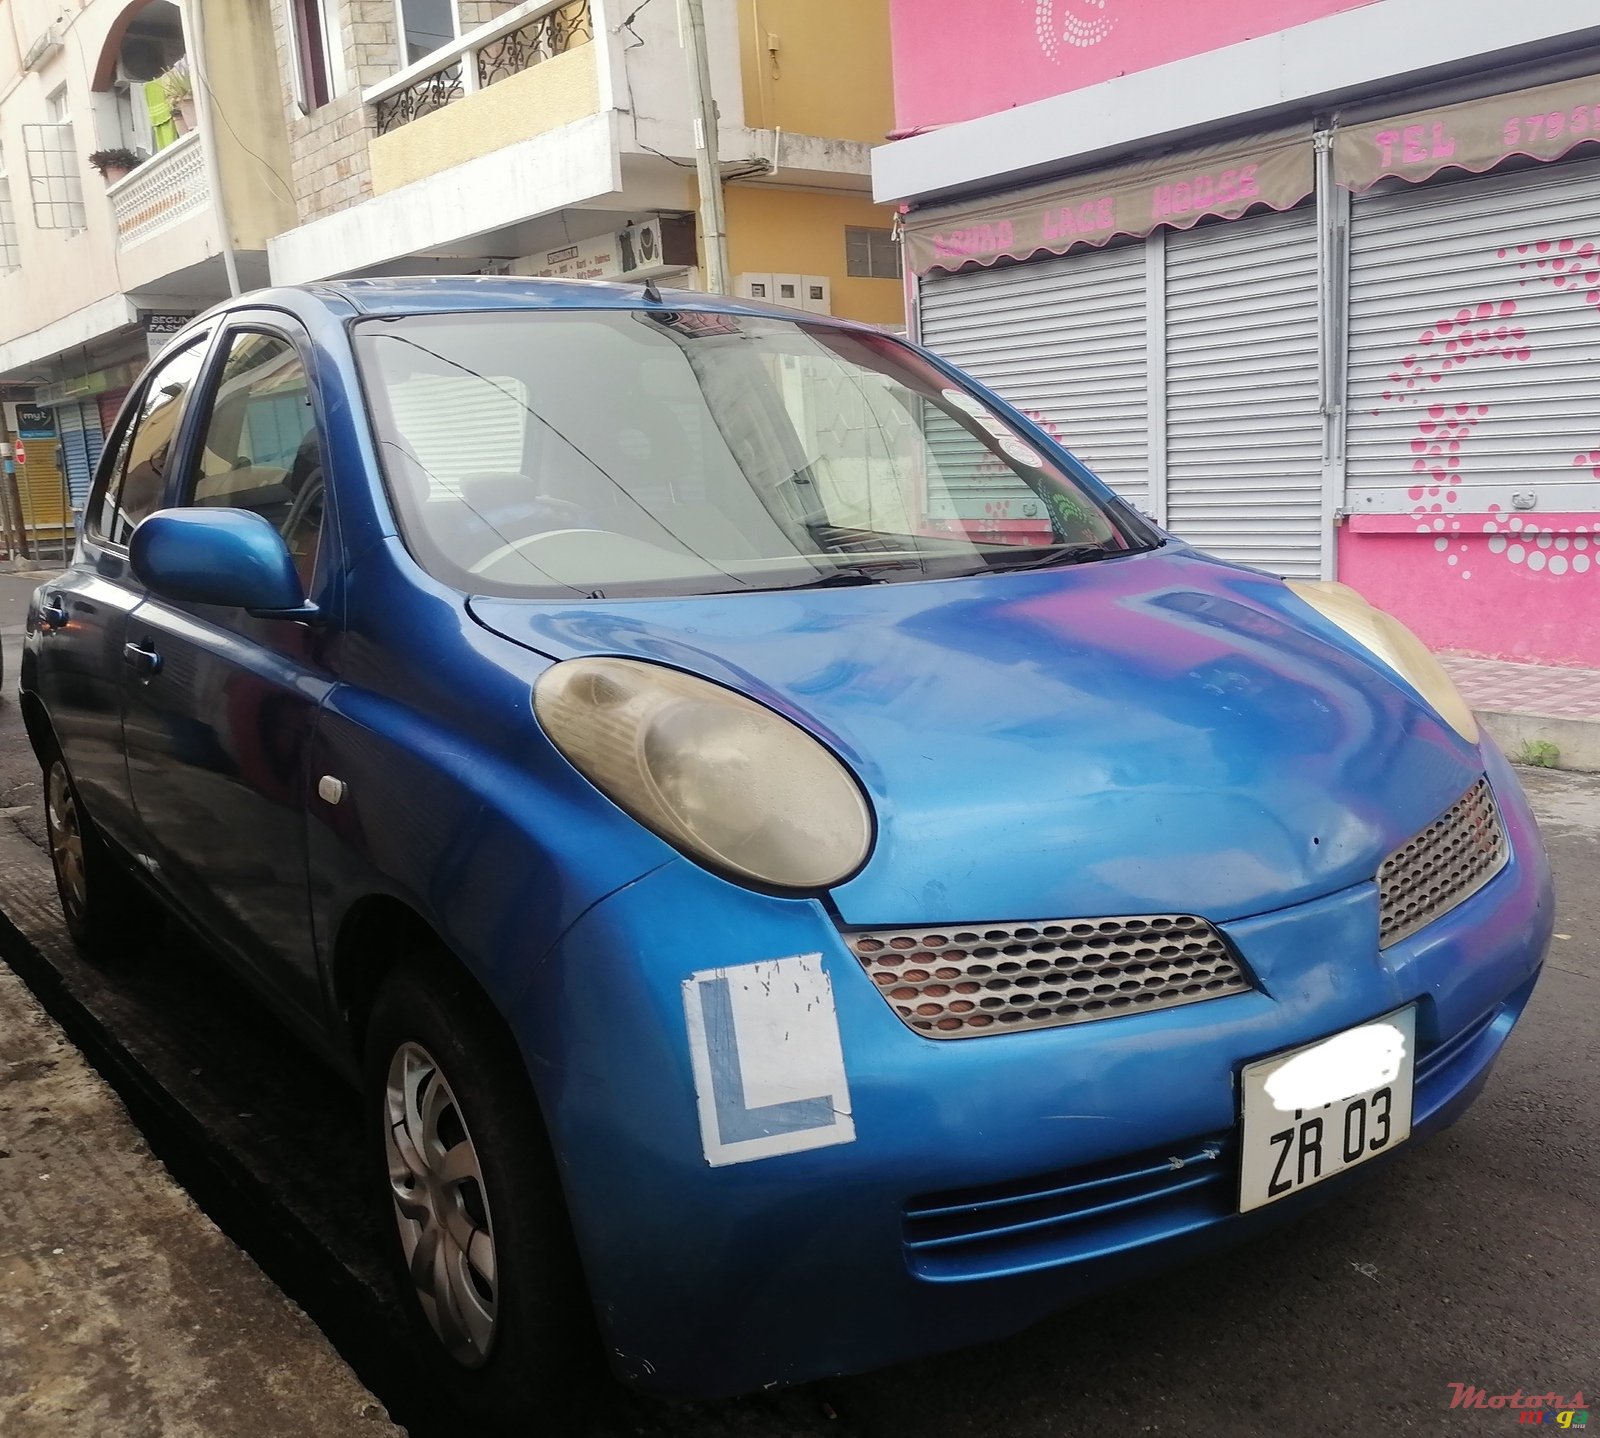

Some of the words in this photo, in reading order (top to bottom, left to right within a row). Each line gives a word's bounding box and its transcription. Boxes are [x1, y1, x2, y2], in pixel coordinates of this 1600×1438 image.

[1375, 120, 1456, 168] TEL
[1152, 164, 1260, 219] HOUSE
[698, 978, 836, 1145] L
[1268, 1117, 1323, 1198] ZR
[1343, 1087, 1392, 1163] 03
